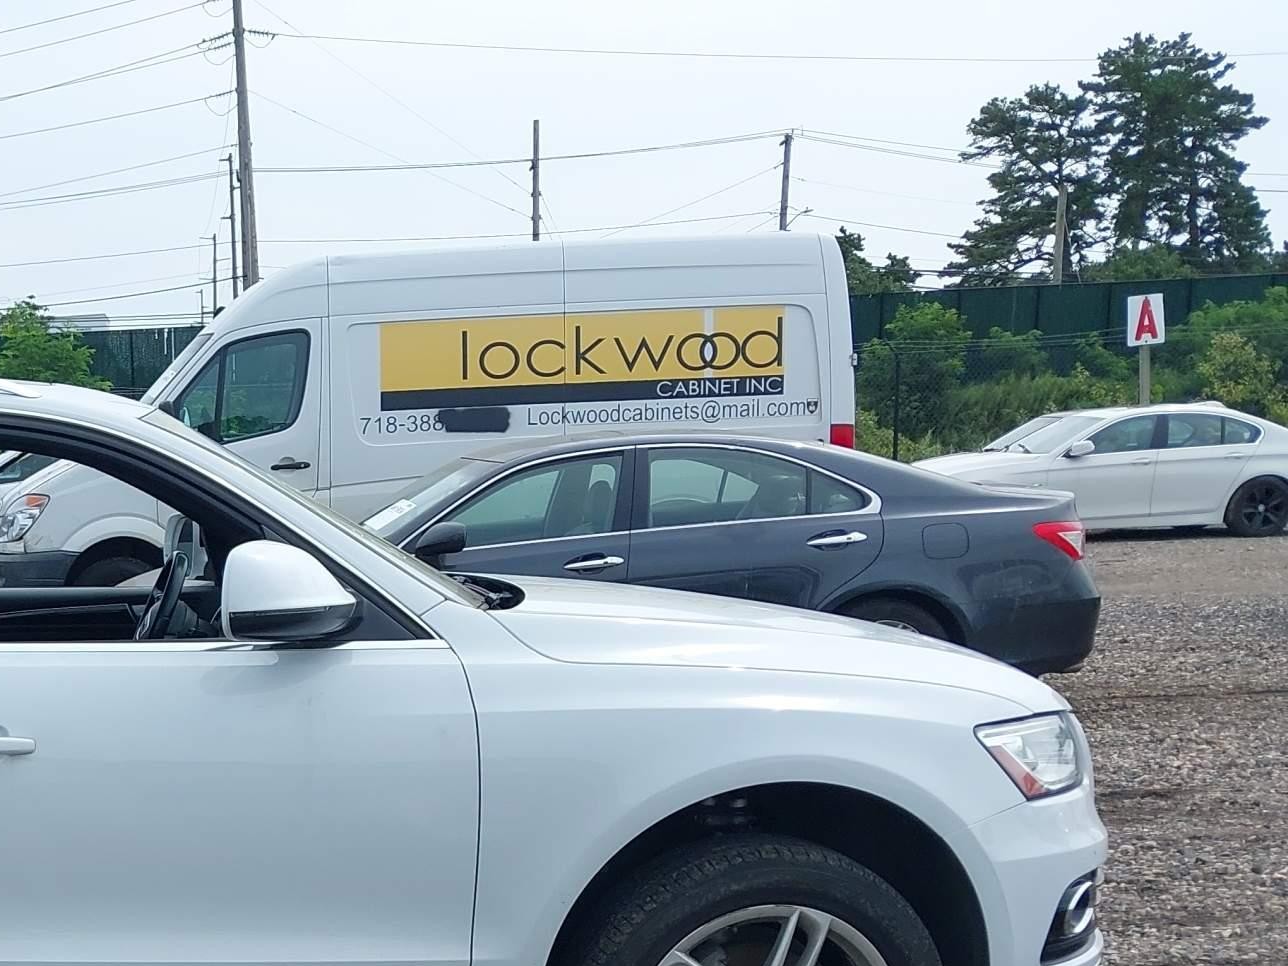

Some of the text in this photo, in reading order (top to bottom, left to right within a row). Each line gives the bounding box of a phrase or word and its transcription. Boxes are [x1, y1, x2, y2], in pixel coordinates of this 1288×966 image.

[1134, 296, 1158, 341] A
[461, 316, 784, 380] lockwood
[656, 376, 783, 397] CABINET INC
[527, 398, 806, 425] Lockwoodcabinets@mail.com
